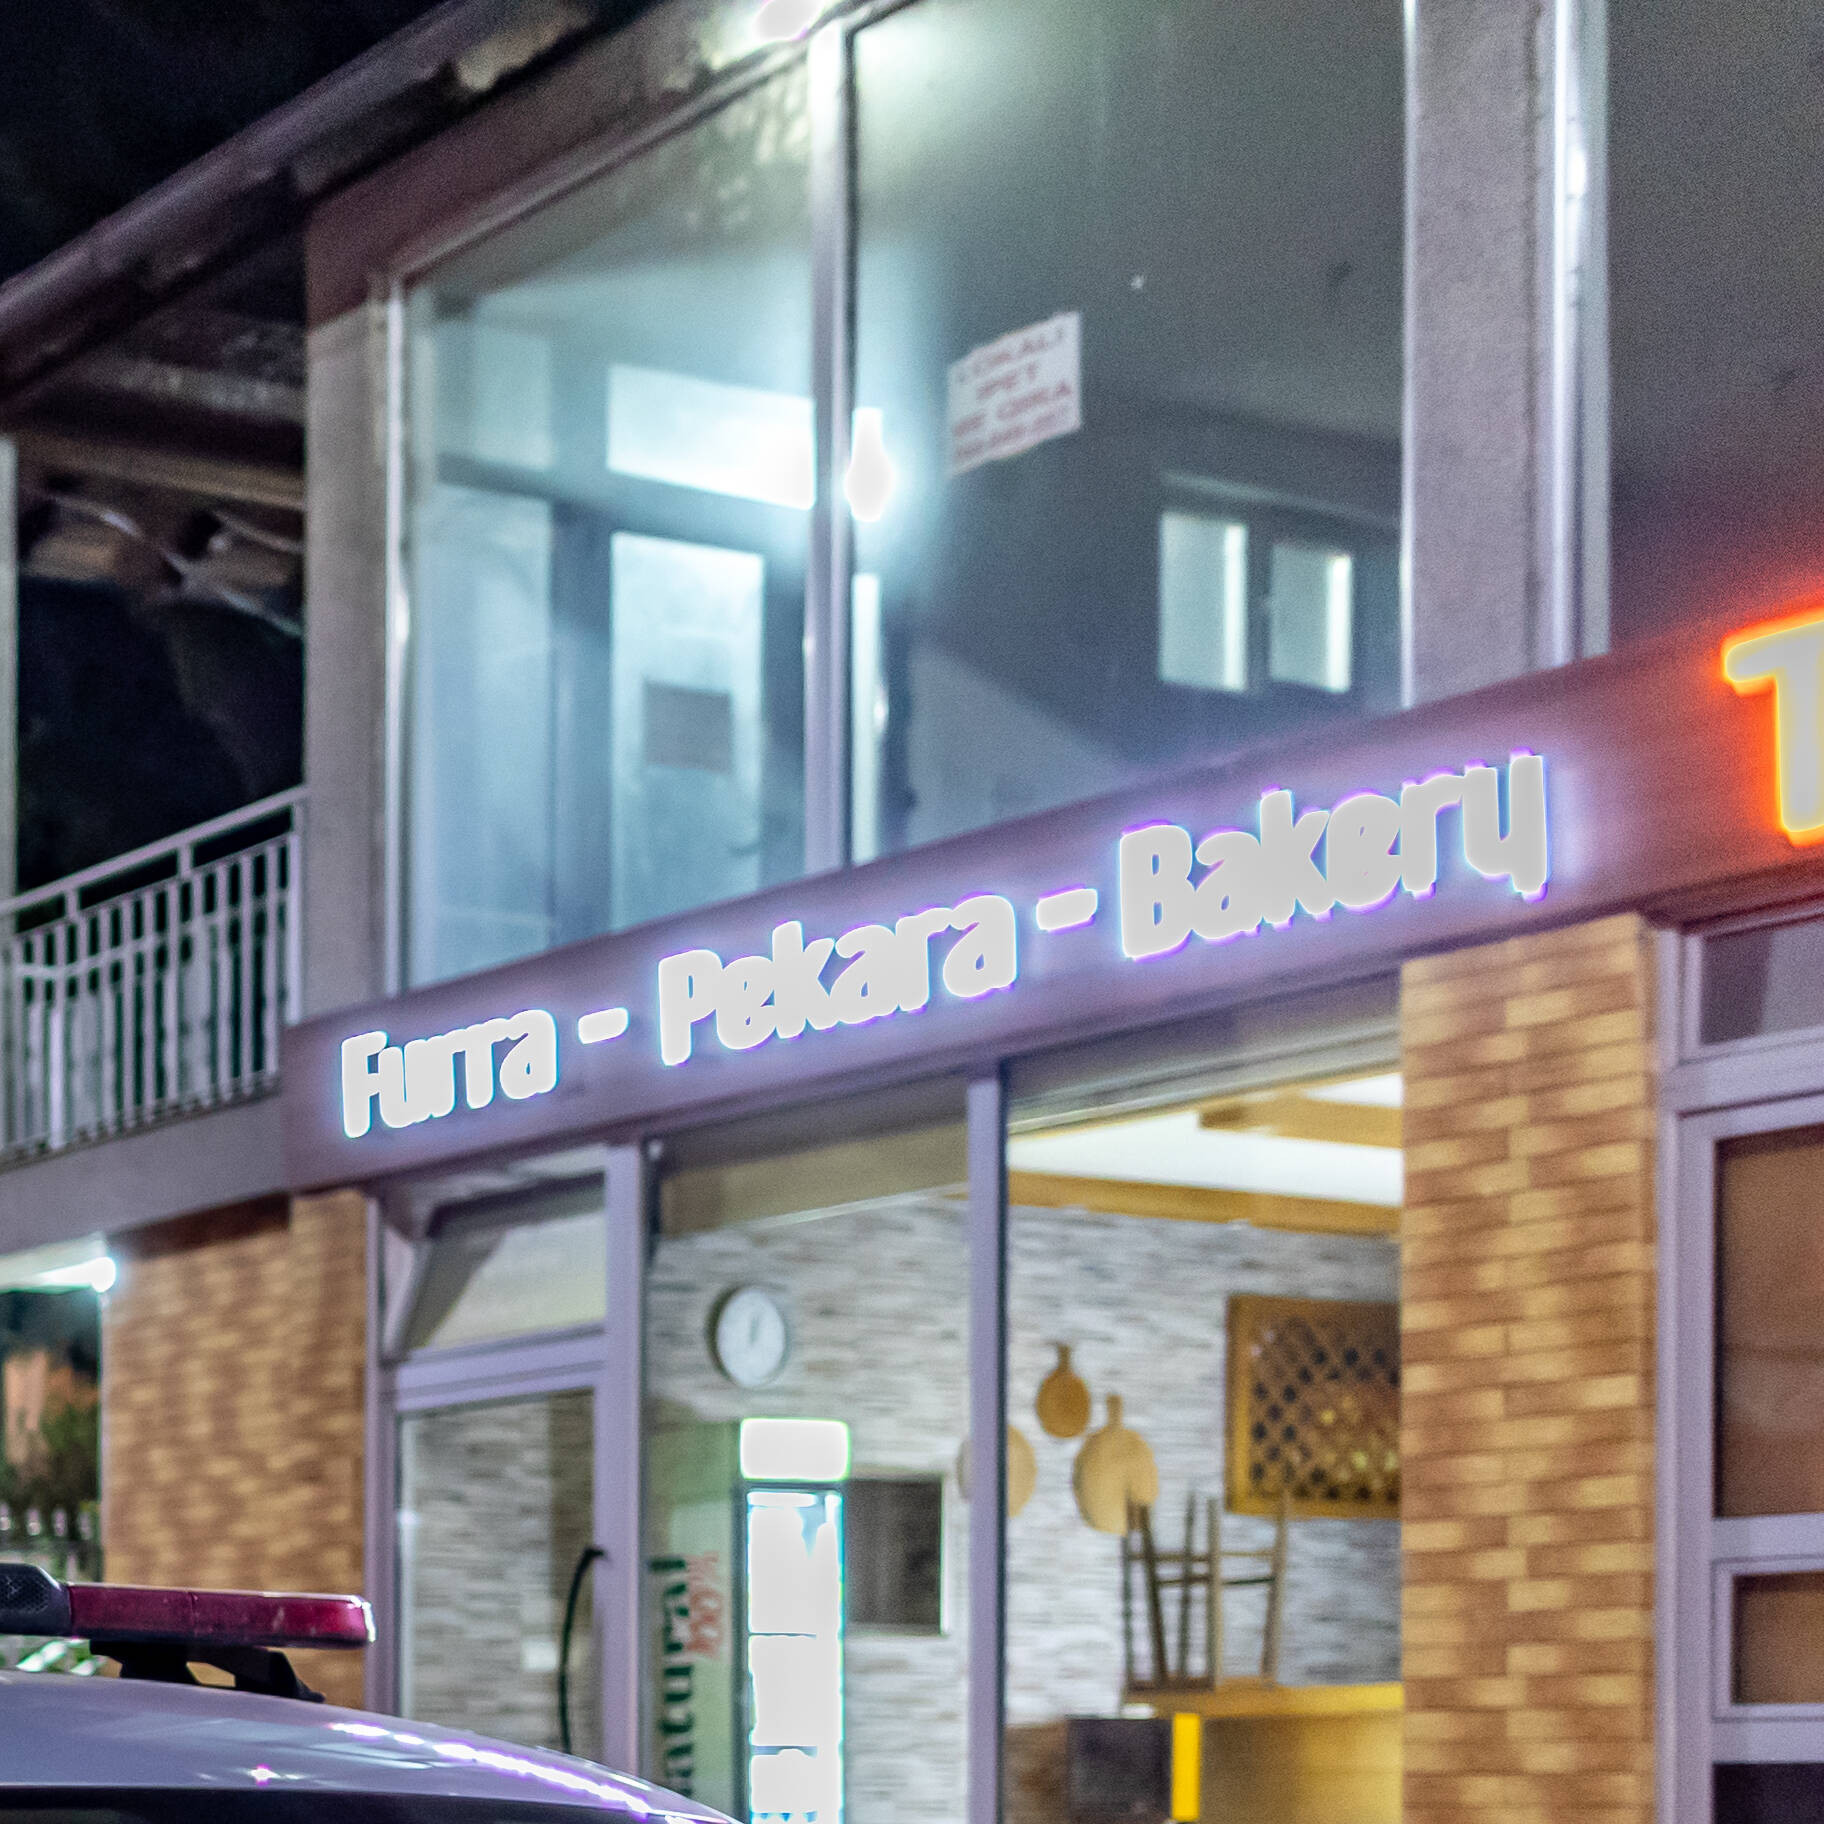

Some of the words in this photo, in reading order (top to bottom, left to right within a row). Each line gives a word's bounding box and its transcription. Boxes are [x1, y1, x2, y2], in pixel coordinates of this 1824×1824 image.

[340, 1008, 558, 1138] Furra
[658, 894, 1018, 1066] Pekara
[1119, 750, 1548, 960] Bakery
[648, 1556, 693, 1799] atural
